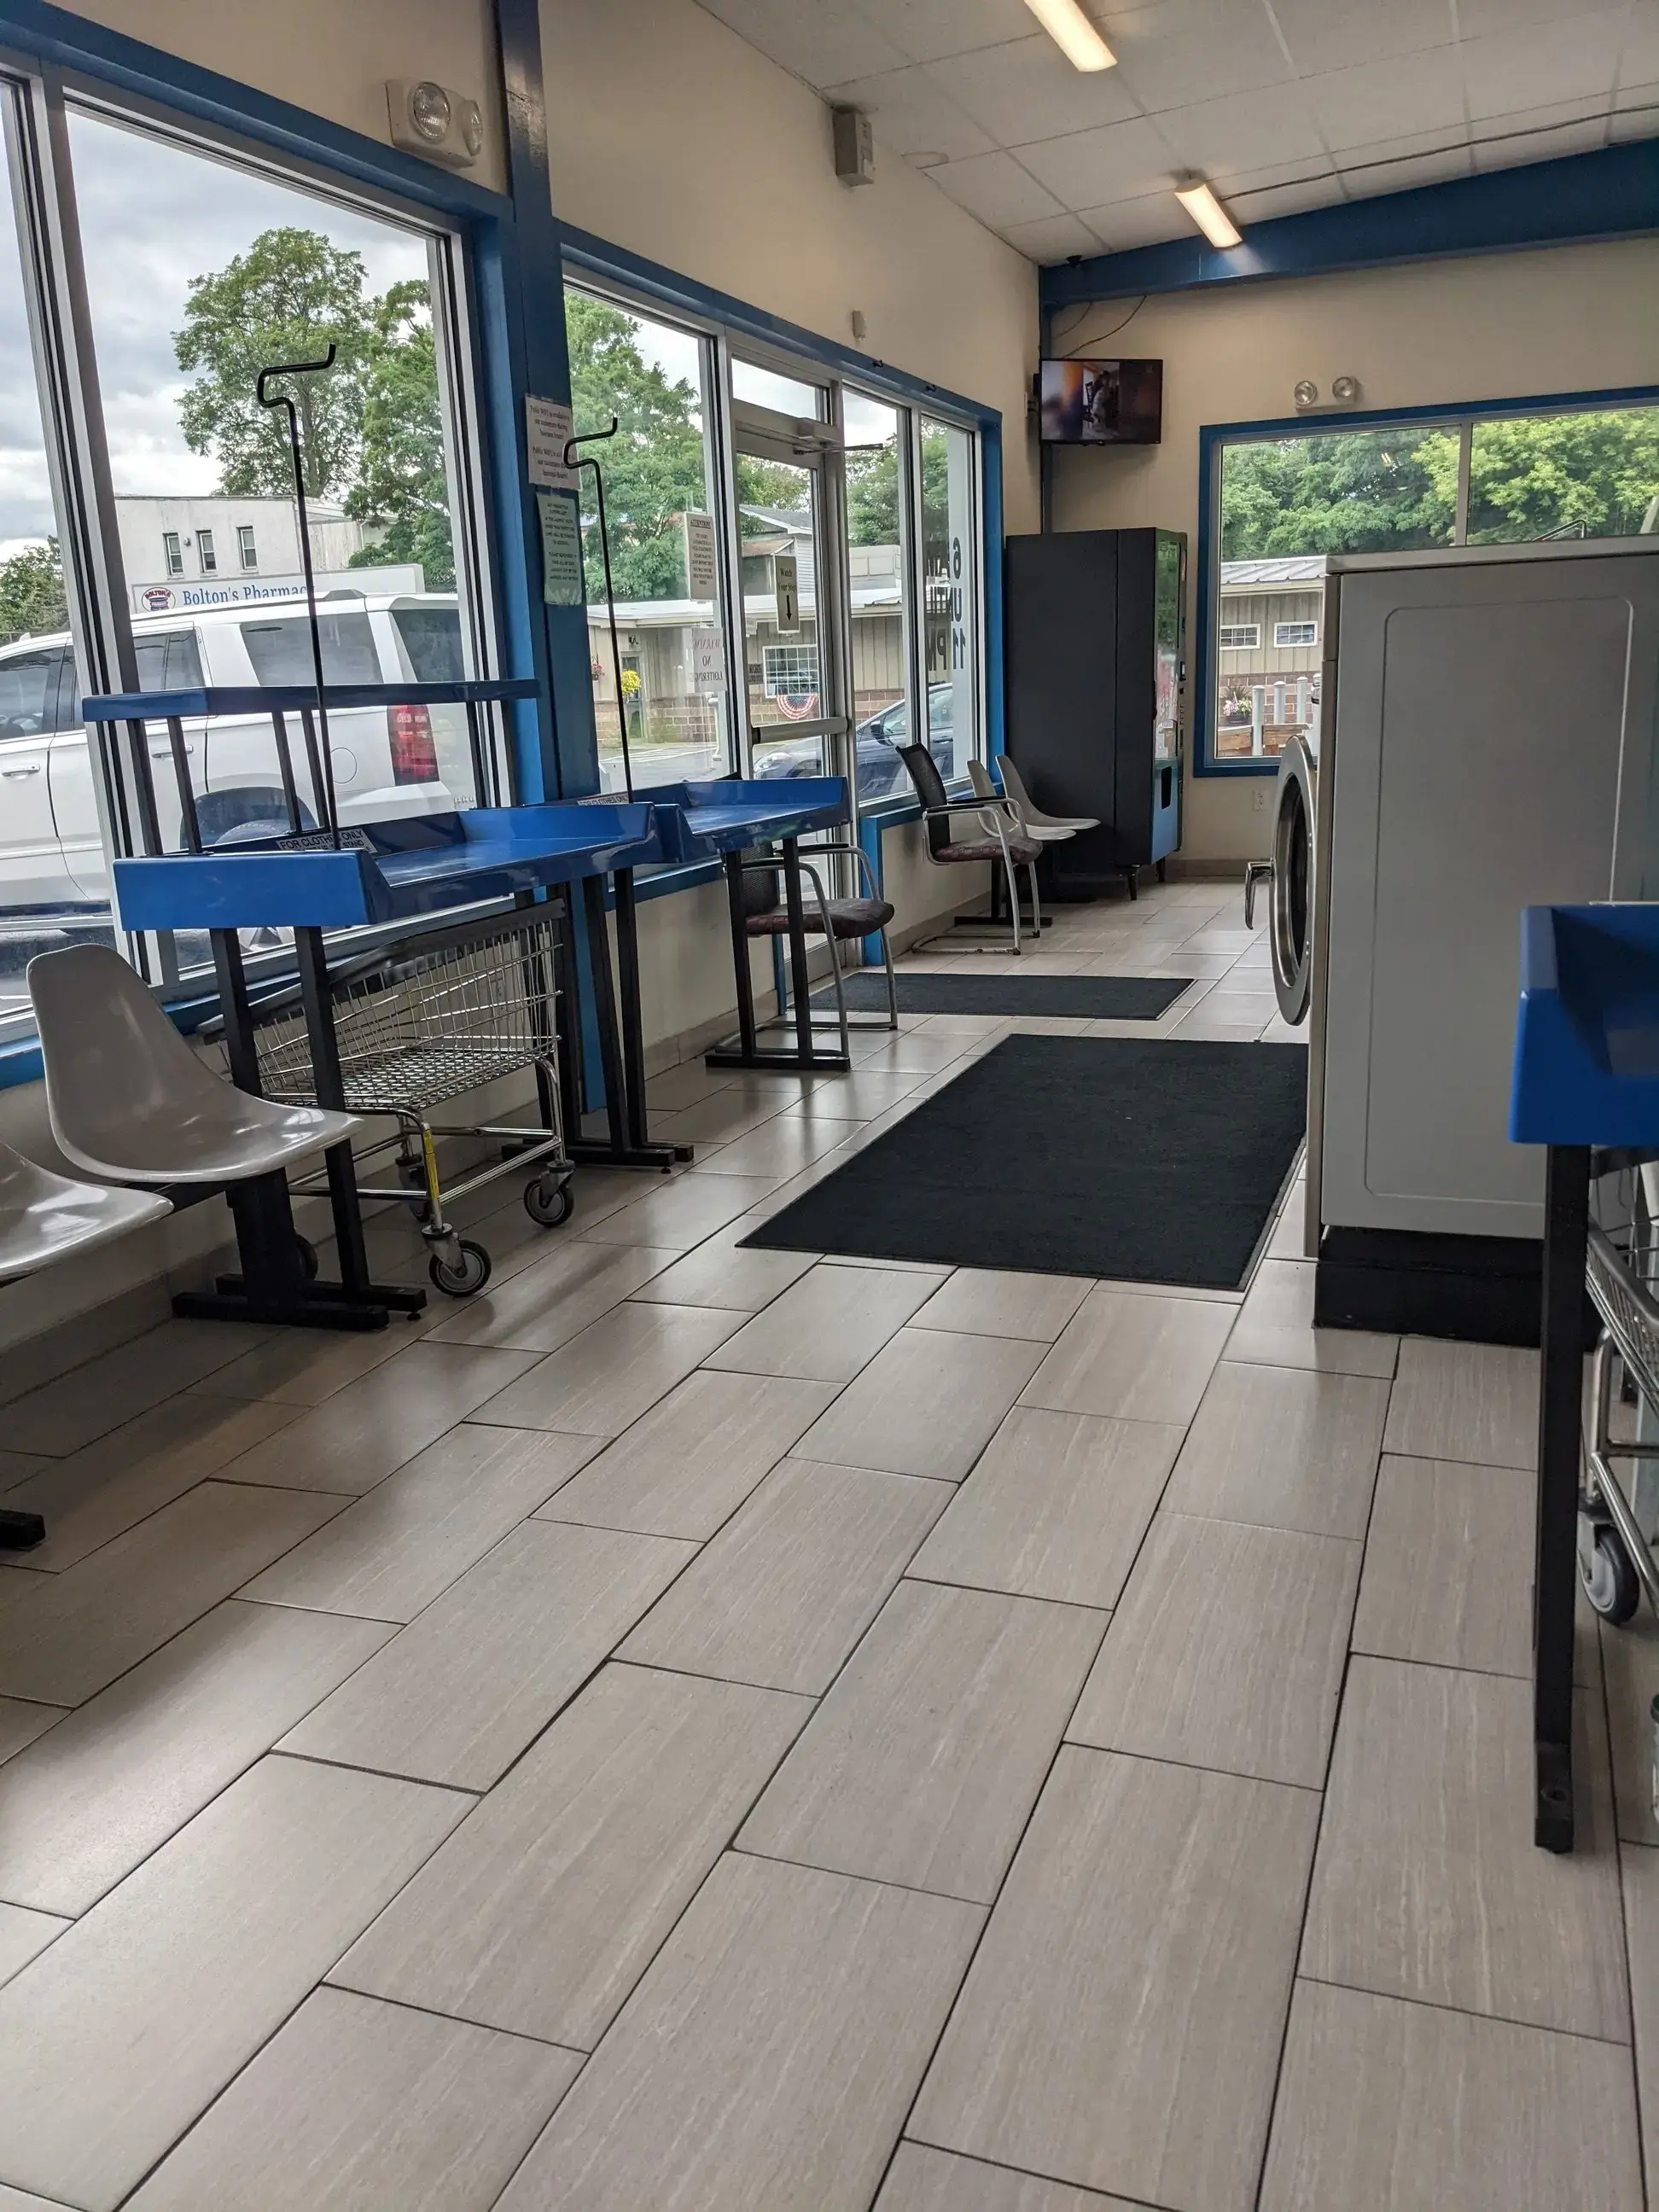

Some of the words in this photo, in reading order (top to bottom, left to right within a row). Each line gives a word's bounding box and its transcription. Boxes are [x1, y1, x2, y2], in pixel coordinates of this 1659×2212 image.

[182, 586, 239, 606] Bolton's
[242, 585, 315, 600] Pharmac
[279, 839, 302, 850] FOR
[301, 833, 334, 846] CLOTH
[342, 830, 364, 841] ONLY
